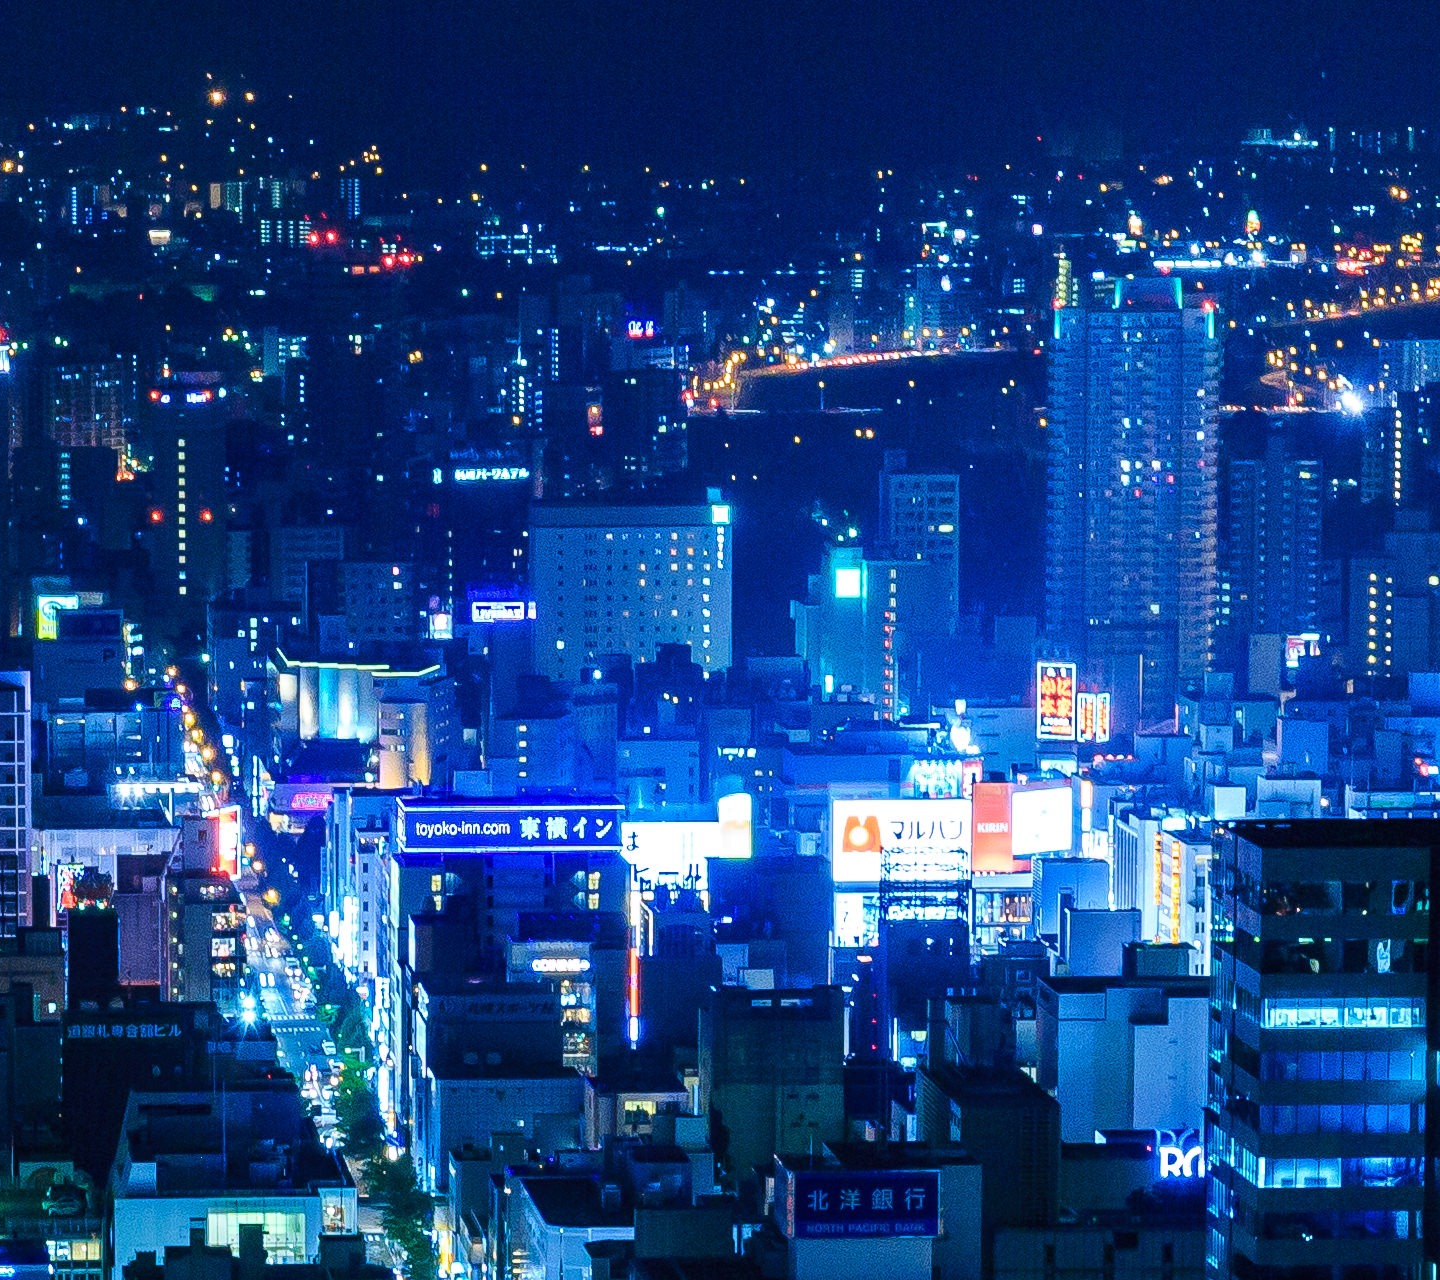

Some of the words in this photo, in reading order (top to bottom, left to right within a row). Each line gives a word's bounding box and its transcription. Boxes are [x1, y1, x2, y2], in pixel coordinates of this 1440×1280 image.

[415, 821, 511, 838] toyoko-inn.com
[519, 816, 613, 840] 東横イン
[889, 820, 963, 840] マルハン
[976, 822, 1009, 833] KIRIN
[807, 1188, 927, 1211] 北洋銀行
[806, 1222, 844, 1234] NORTH
[848, 1222, 890, 1234] PACIFIC
[894, 1222, 926, 1234] BANK
